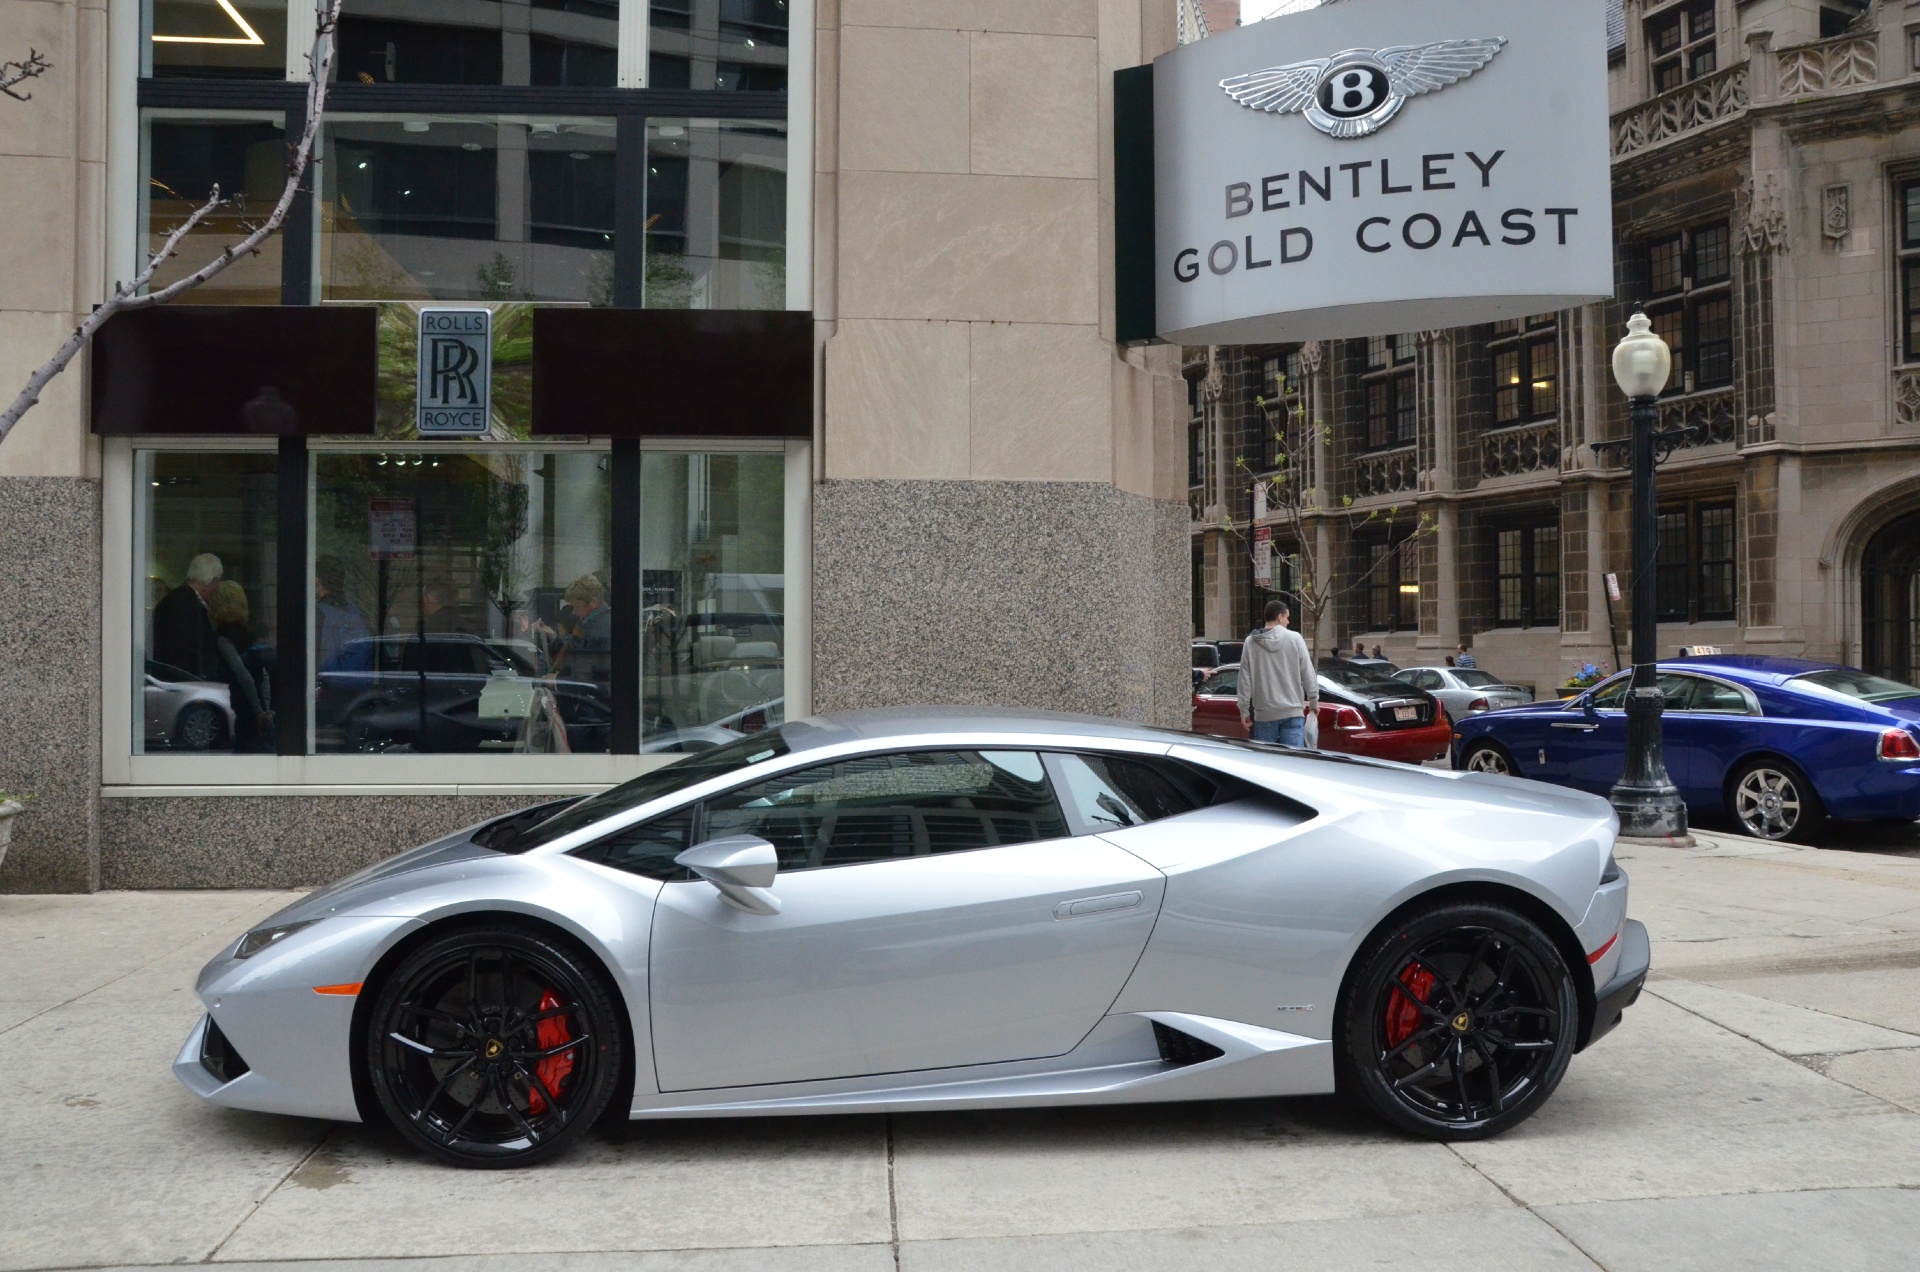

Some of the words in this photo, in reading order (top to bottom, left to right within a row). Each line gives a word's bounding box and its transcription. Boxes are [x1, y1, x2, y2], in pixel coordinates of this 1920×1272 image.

[1330, 67, 1376, 113] B
[1225, 149, 1506, 220] BENTLEY
[1173, 226, 1314, 283] GOLD
[1355, 207, 1579, 253] COAST
[426, 316, 483, 330] ROLLS
[424, 412, 481, 426] ROYCE
